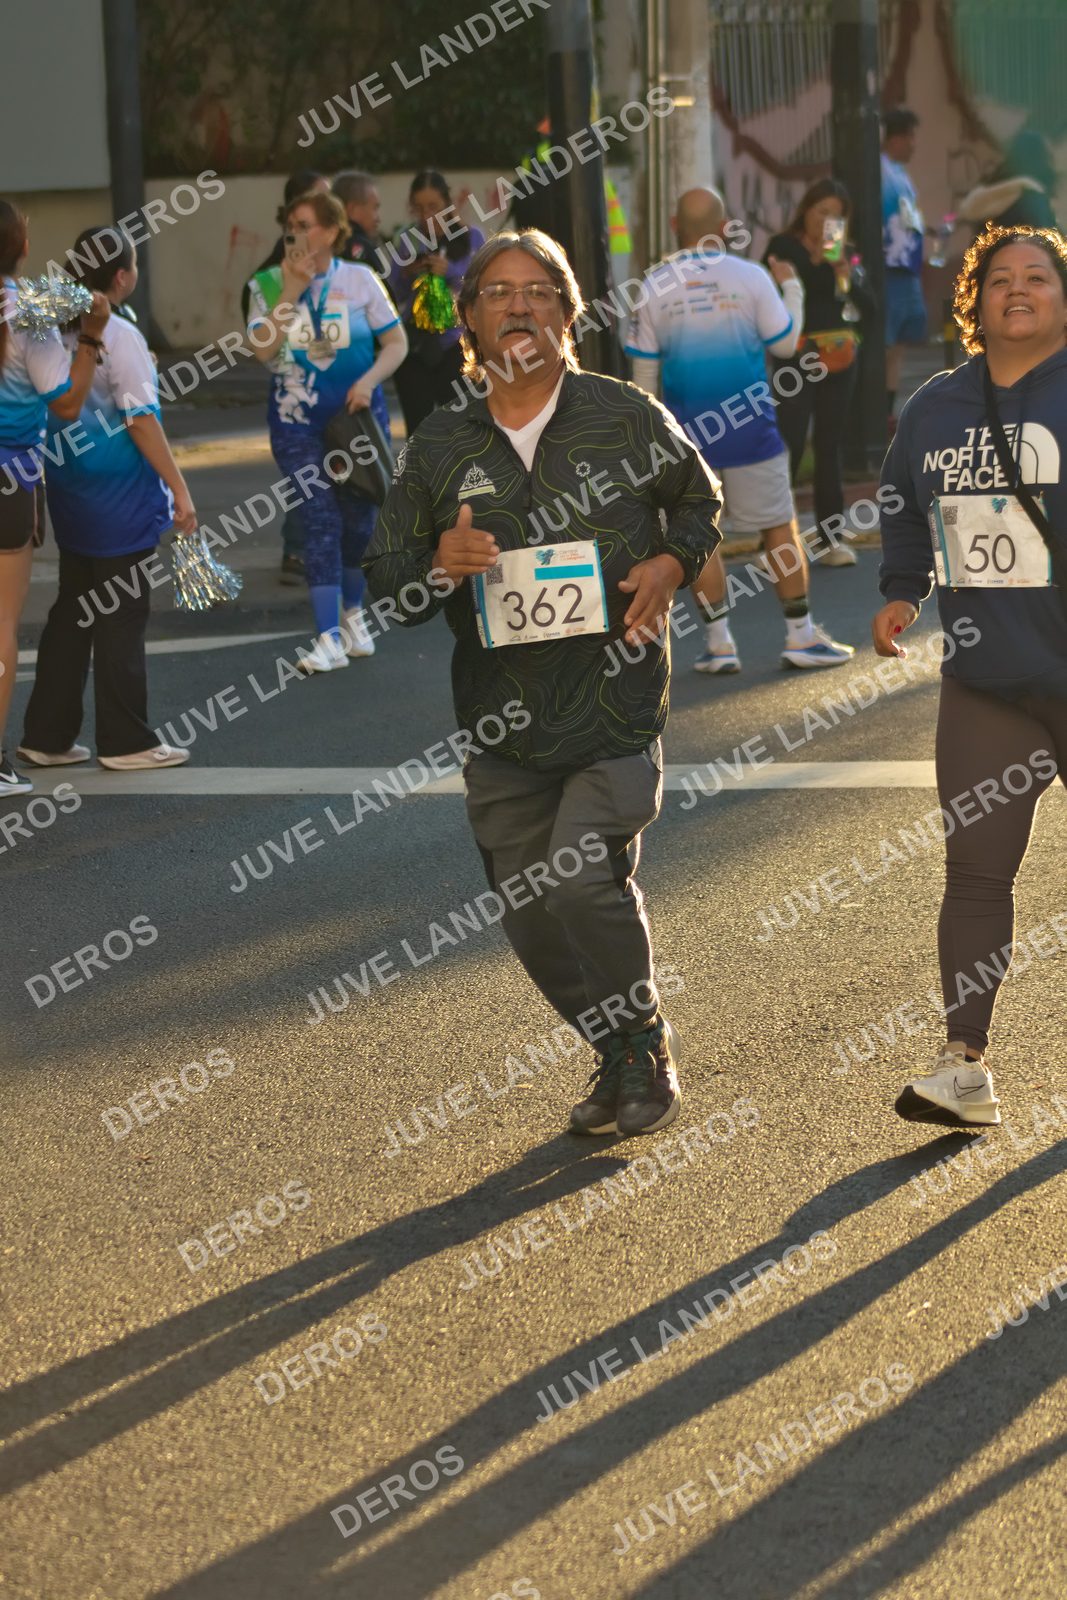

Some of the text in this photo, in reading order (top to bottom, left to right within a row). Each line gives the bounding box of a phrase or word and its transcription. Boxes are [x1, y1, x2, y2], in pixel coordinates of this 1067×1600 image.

[943, 465, 1009, 492] FACE
[964, 533, 1016, 574] 50
[503, 583, 585, 631] 362
